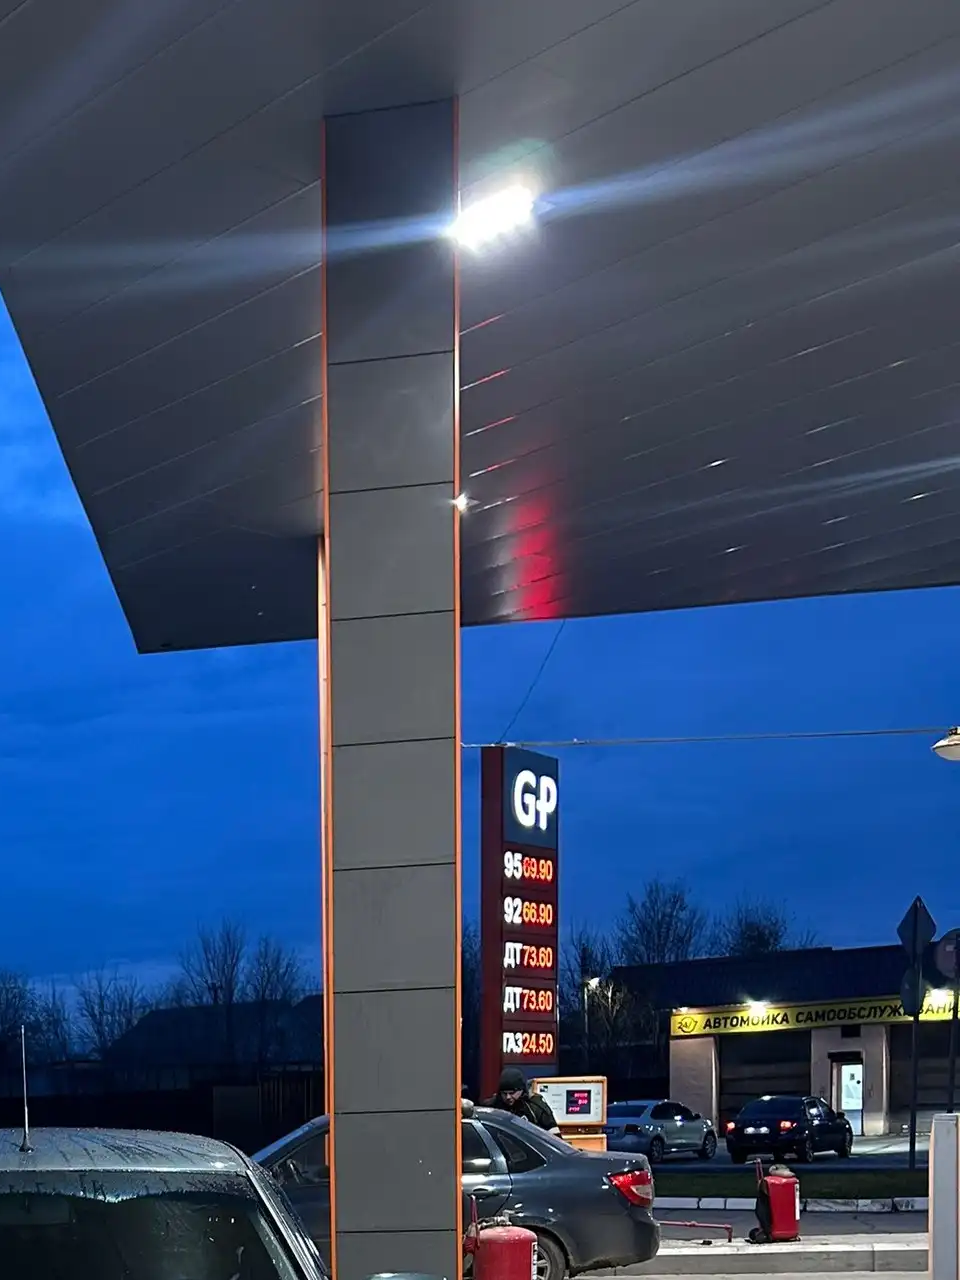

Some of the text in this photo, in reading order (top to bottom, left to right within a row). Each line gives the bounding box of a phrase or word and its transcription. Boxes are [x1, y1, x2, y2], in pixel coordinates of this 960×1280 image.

[514, 769, 558, 831] GP
[504, 850, 523, 880] 95
[504, 896, 553, 925] 92 66.90
[503, 941, 553, 969] ДТ 73.60
[503, 986, 553, 1013] ДТ 73.60
[523, 1034, 553, 1056] 24.50
